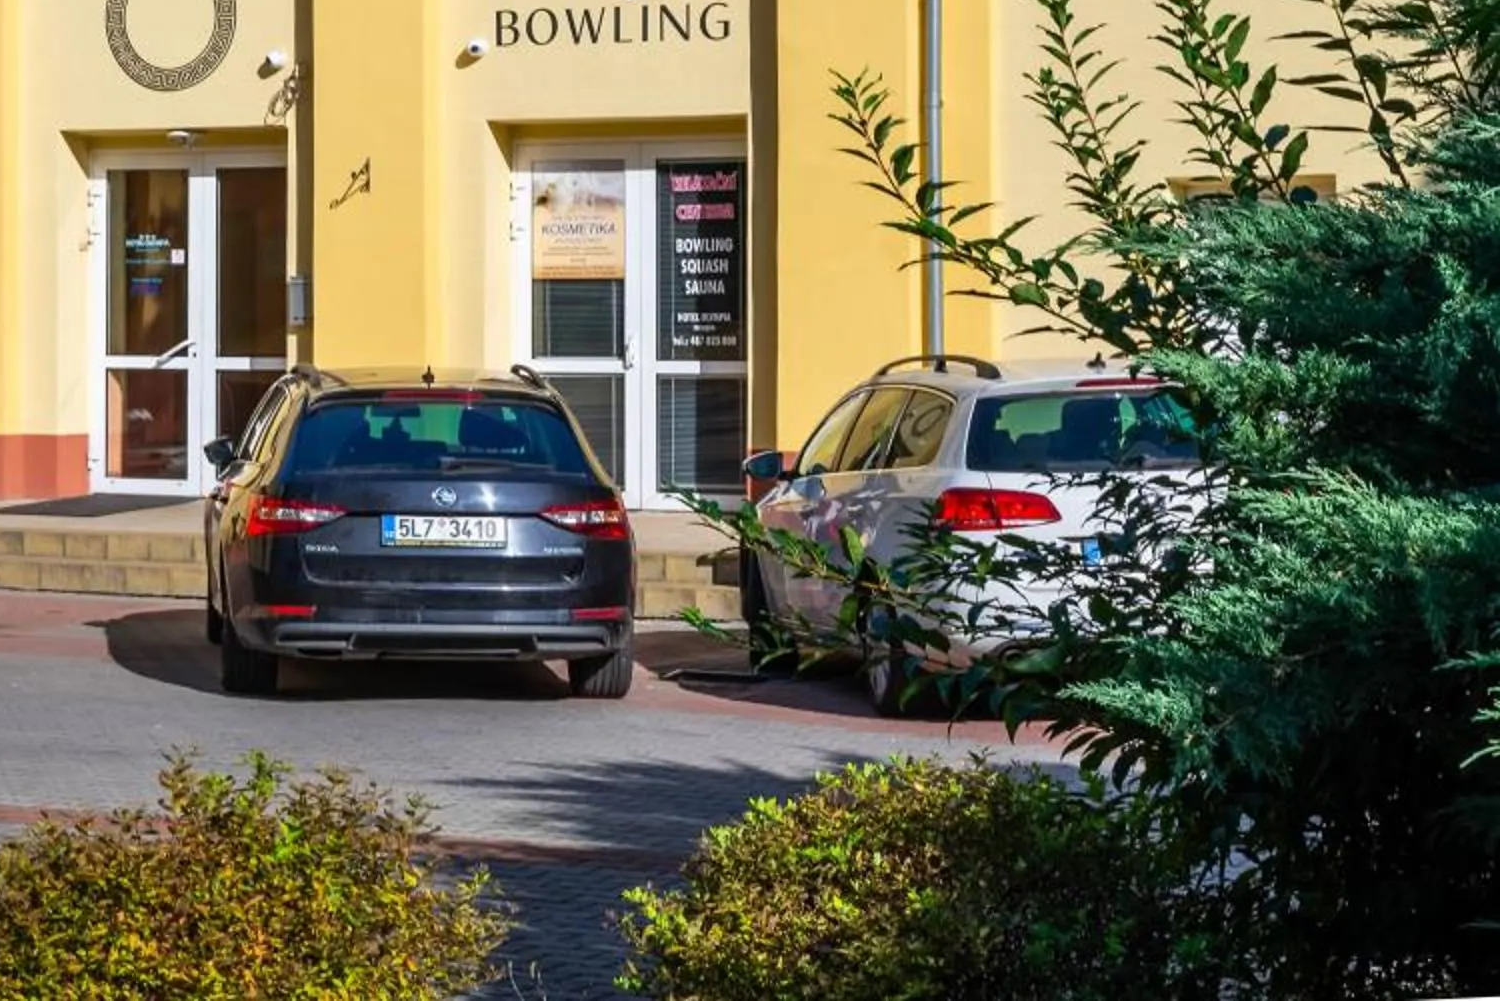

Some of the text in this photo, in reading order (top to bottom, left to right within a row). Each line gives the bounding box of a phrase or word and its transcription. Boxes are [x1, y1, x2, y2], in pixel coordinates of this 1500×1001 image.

[495, 2, 731, 47] BOWLING
[541, 222, 615, 235] KOSMETIKA
[675, 237, 733, 253] BOWLING
[681, 258, 729, 274] SQUASH
[685, 279, 725, 295] SAUNA
[400, 518, 497, 539] 5L7 3410
